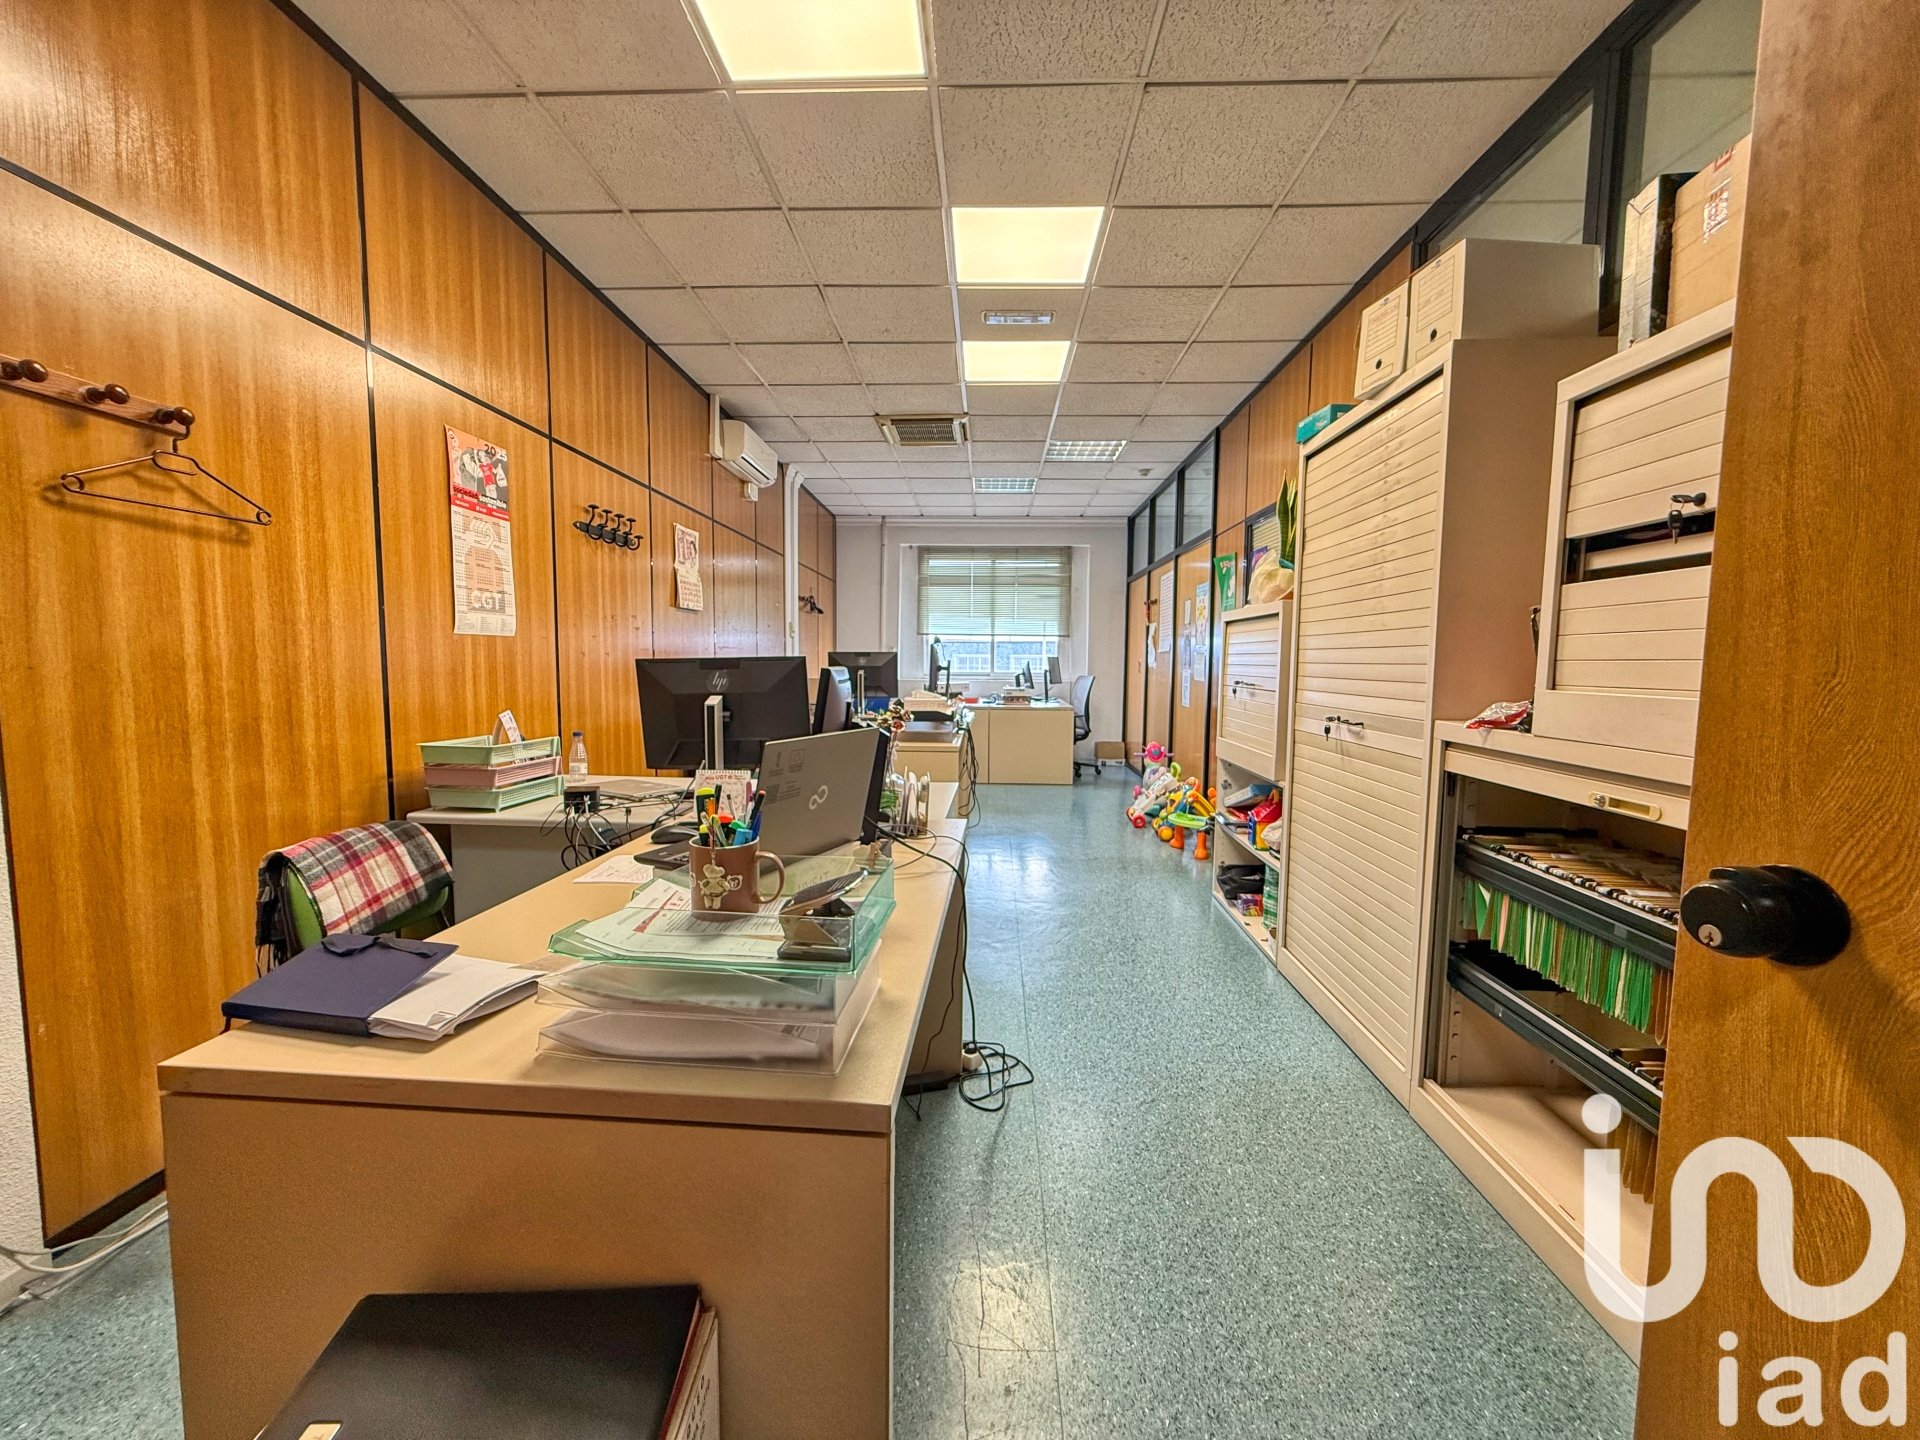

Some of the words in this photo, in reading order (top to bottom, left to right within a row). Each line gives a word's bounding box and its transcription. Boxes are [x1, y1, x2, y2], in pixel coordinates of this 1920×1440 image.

[484, 443, 508, 461] 2025
[470, 590, 503, 611] CGT
[712, 671, 727, 691] hp
